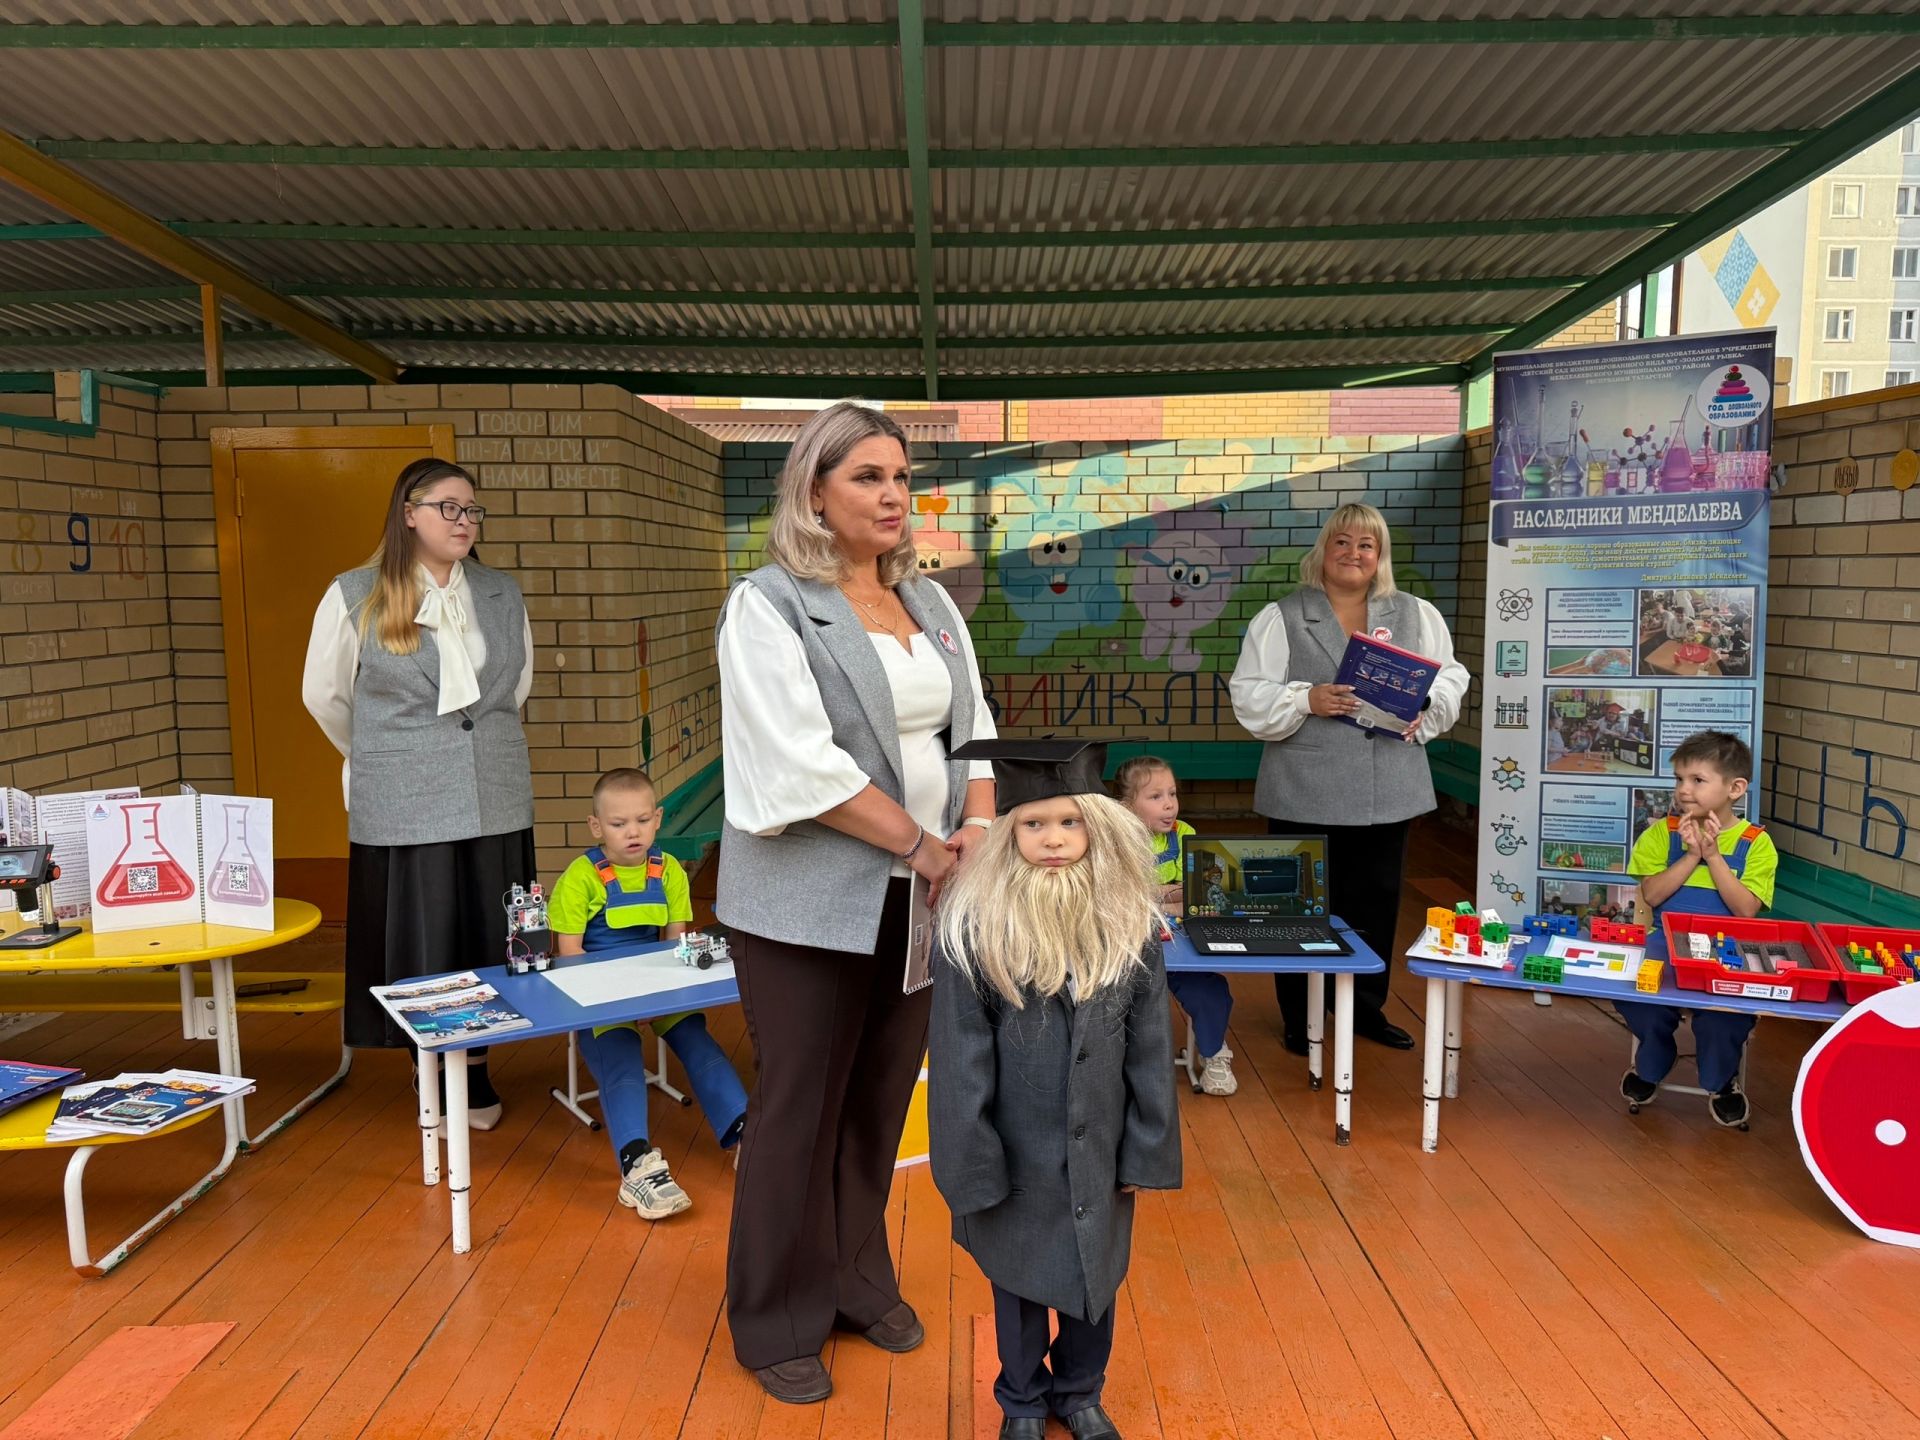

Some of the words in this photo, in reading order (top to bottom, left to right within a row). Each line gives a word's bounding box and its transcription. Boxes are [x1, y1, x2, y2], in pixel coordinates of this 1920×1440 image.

[1651, 347, 1720, 358] ОБРАЗОВАТЕЛЬНОЕ
[1721, 342, 1773, 352] УЧРЕЖДЕНИЕ
[1708, 404, 1724, 412] ГОД
[1708, 411, 1756, 420] ОБРАЗОВАНИЯ
[481, 464, 548, 488] НАМИ
[553, 465, 620, 488] ВМЕСТЕ
[1513, 507, 1623, 530] НАСЛЕДНИКИ
[1627, 501, 1743, 526] МЕНДЕЛЕЕВА
[67, 512, 92, 572] 9
[109, 520, 147, 581] 10
[1777, 988, 1789, 996] 30
